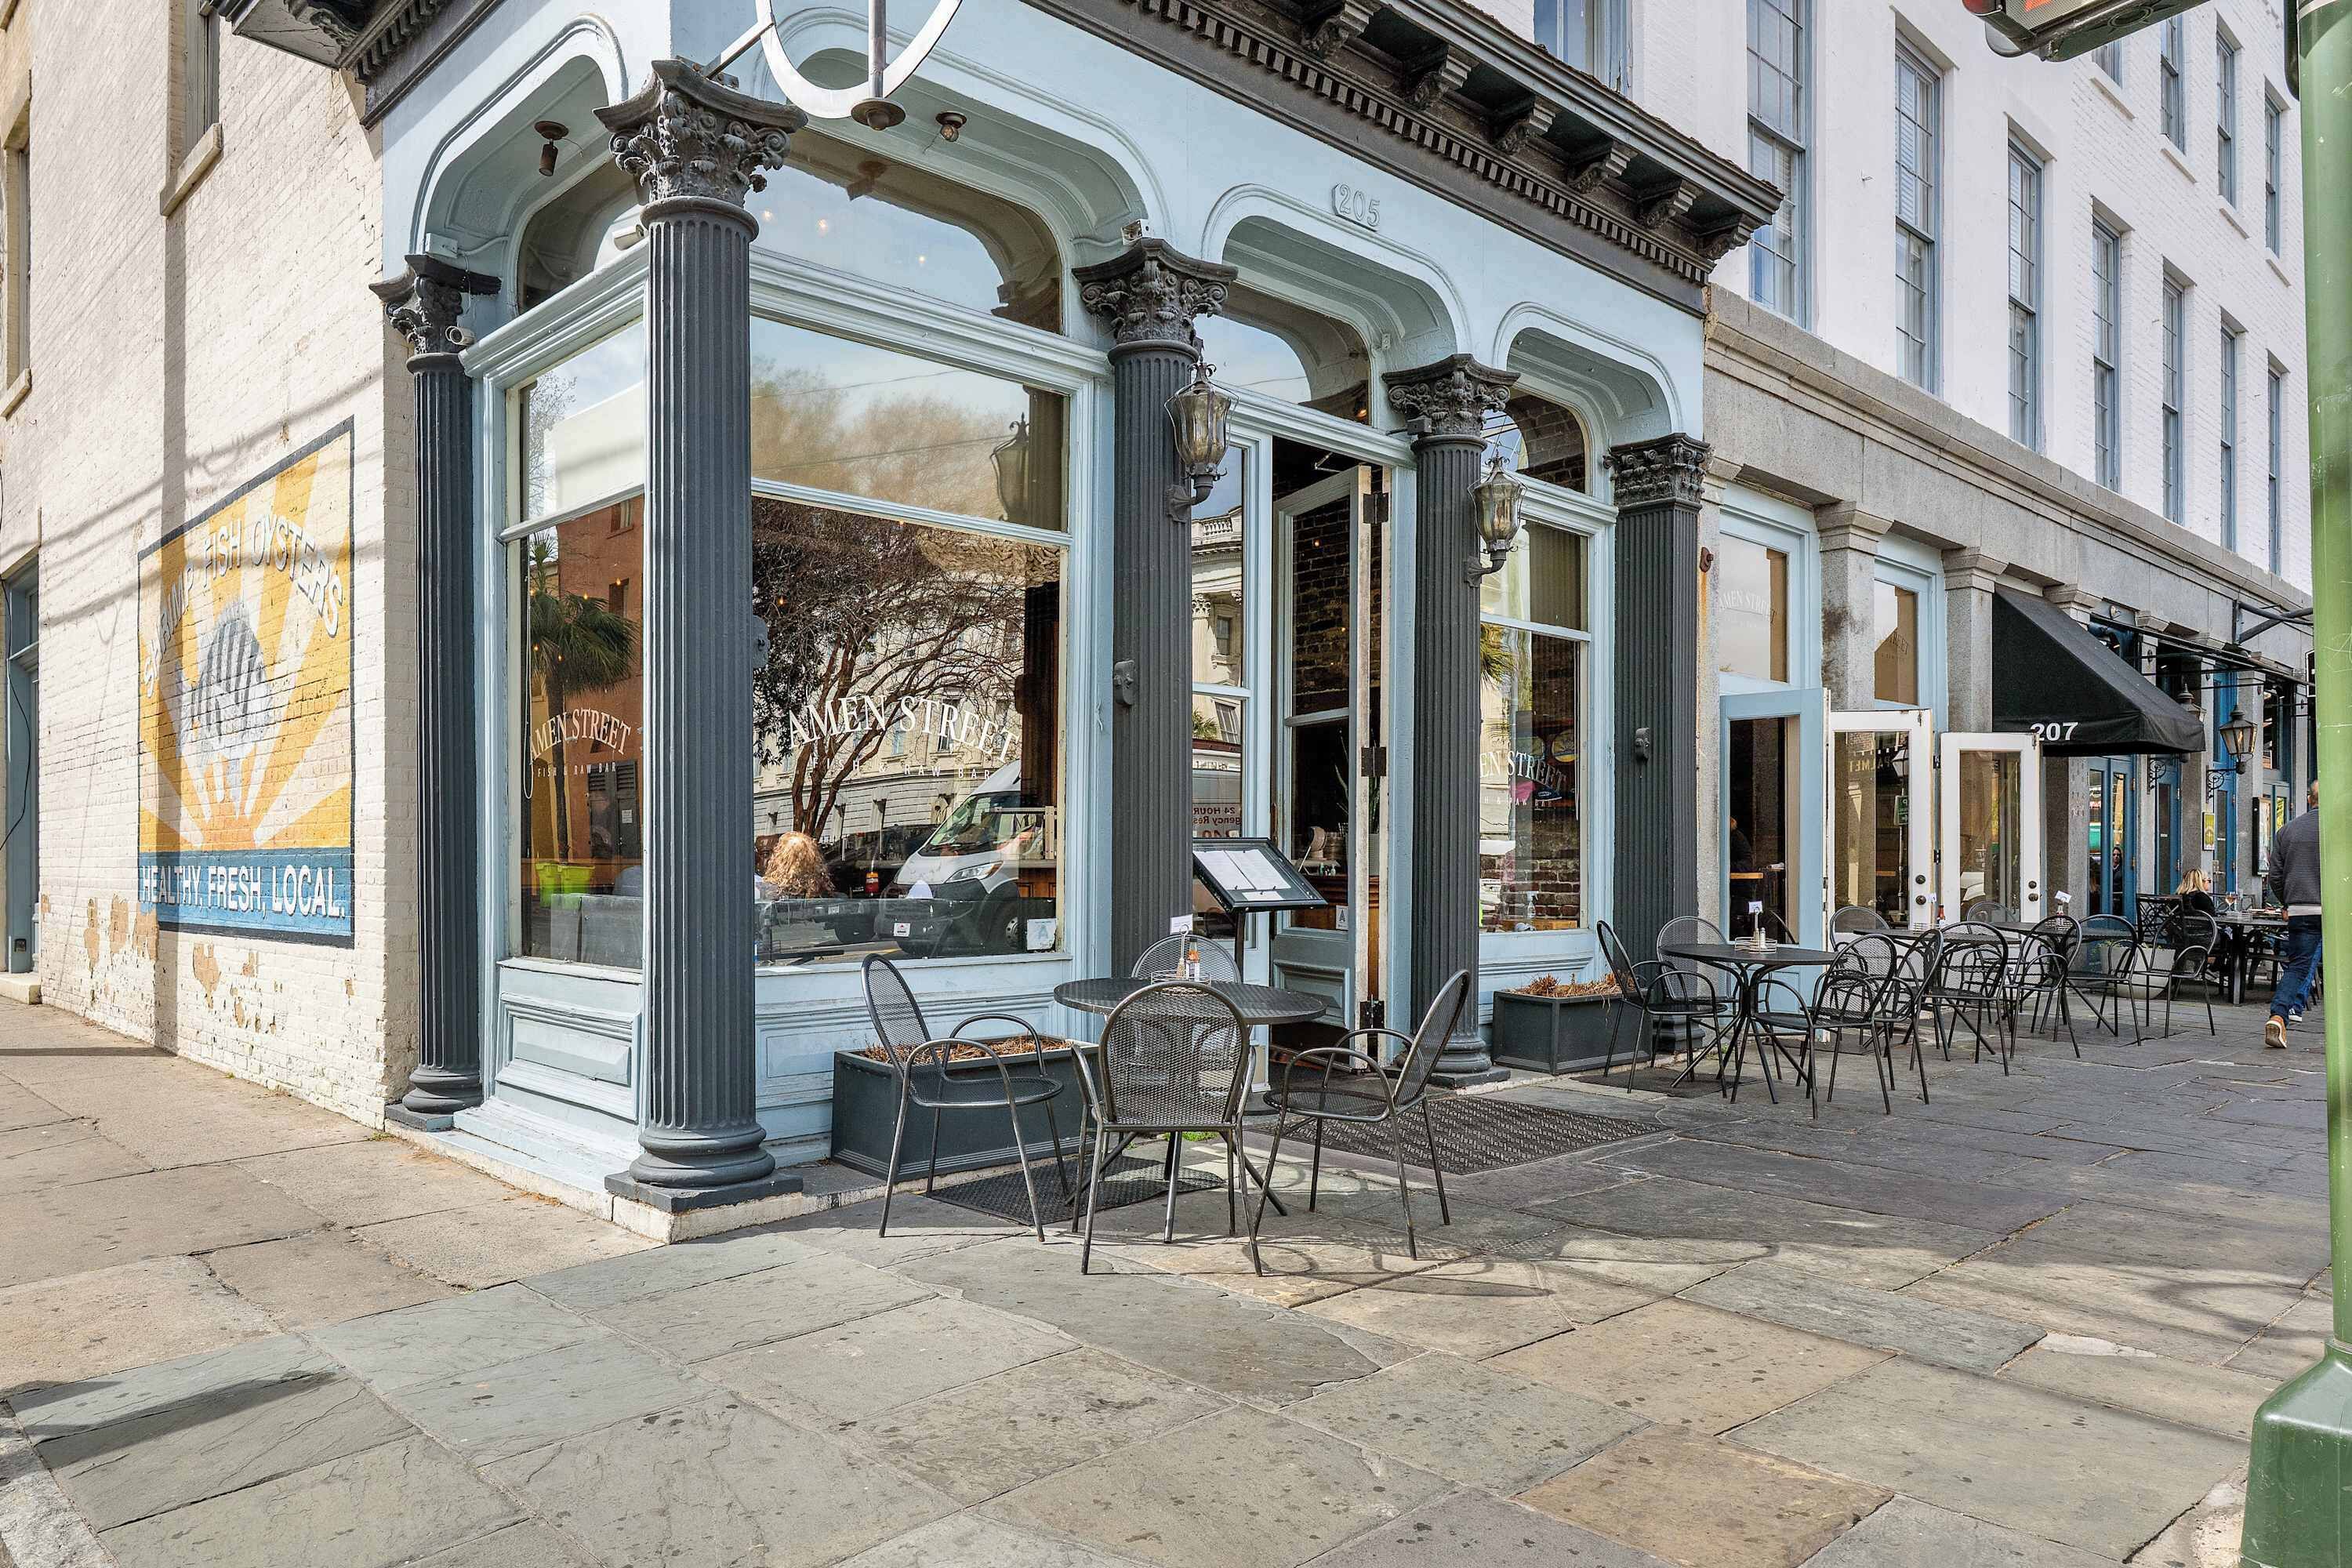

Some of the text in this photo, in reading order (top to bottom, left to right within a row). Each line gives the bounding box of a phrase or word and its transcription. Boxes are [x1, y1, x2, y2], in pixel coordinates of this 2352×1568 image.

[1339, 183, 1380, 227] 205
[144, 514, 343, 698] SHRIMP FISH OYSTERS
[530, 707, 632, 760] AMEN STREET
[789, 694, 1020, 764] AMEN STREET
[2030, 721, 2078, 742] 207
[538, 767, 557, 778] FISH
[574, 764, 592, 775] RAW
[598, 761, 616, 773] BAR
[812, 757, 990, 779] FISH & RAW BAR
[1506, 750, 1566, 793] STREET
[208, 865, 267, 920] FRESH,
[272, 864, 346, 918] LOCAL.
